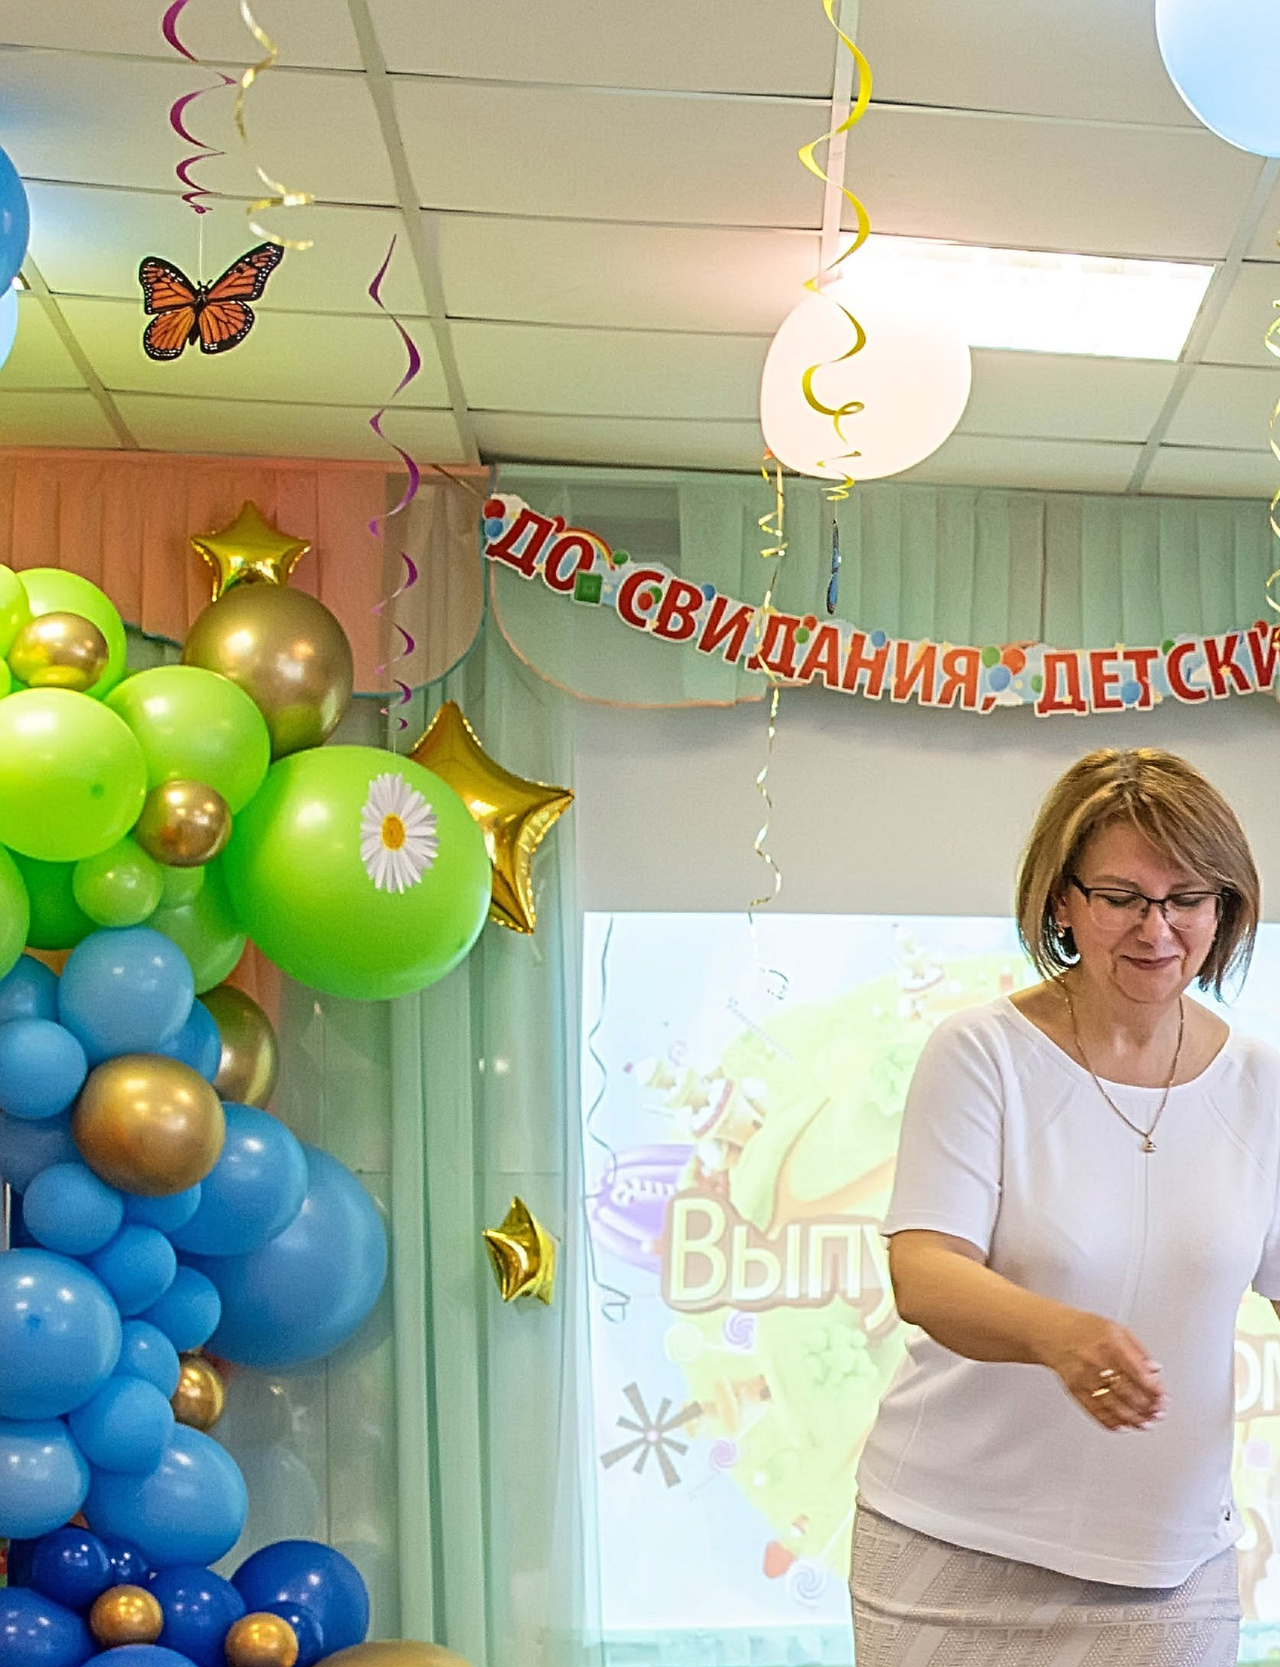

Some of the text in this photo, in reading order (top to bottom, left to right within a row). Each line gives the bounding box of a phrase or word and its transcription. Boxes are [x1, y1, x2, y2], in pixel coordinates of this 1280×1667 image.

[485, 508, 595, 593] ДО
[618, 569, 998, 712] СВИДАНИЯ,
[669, 1196, 896, 1333] Выпу
